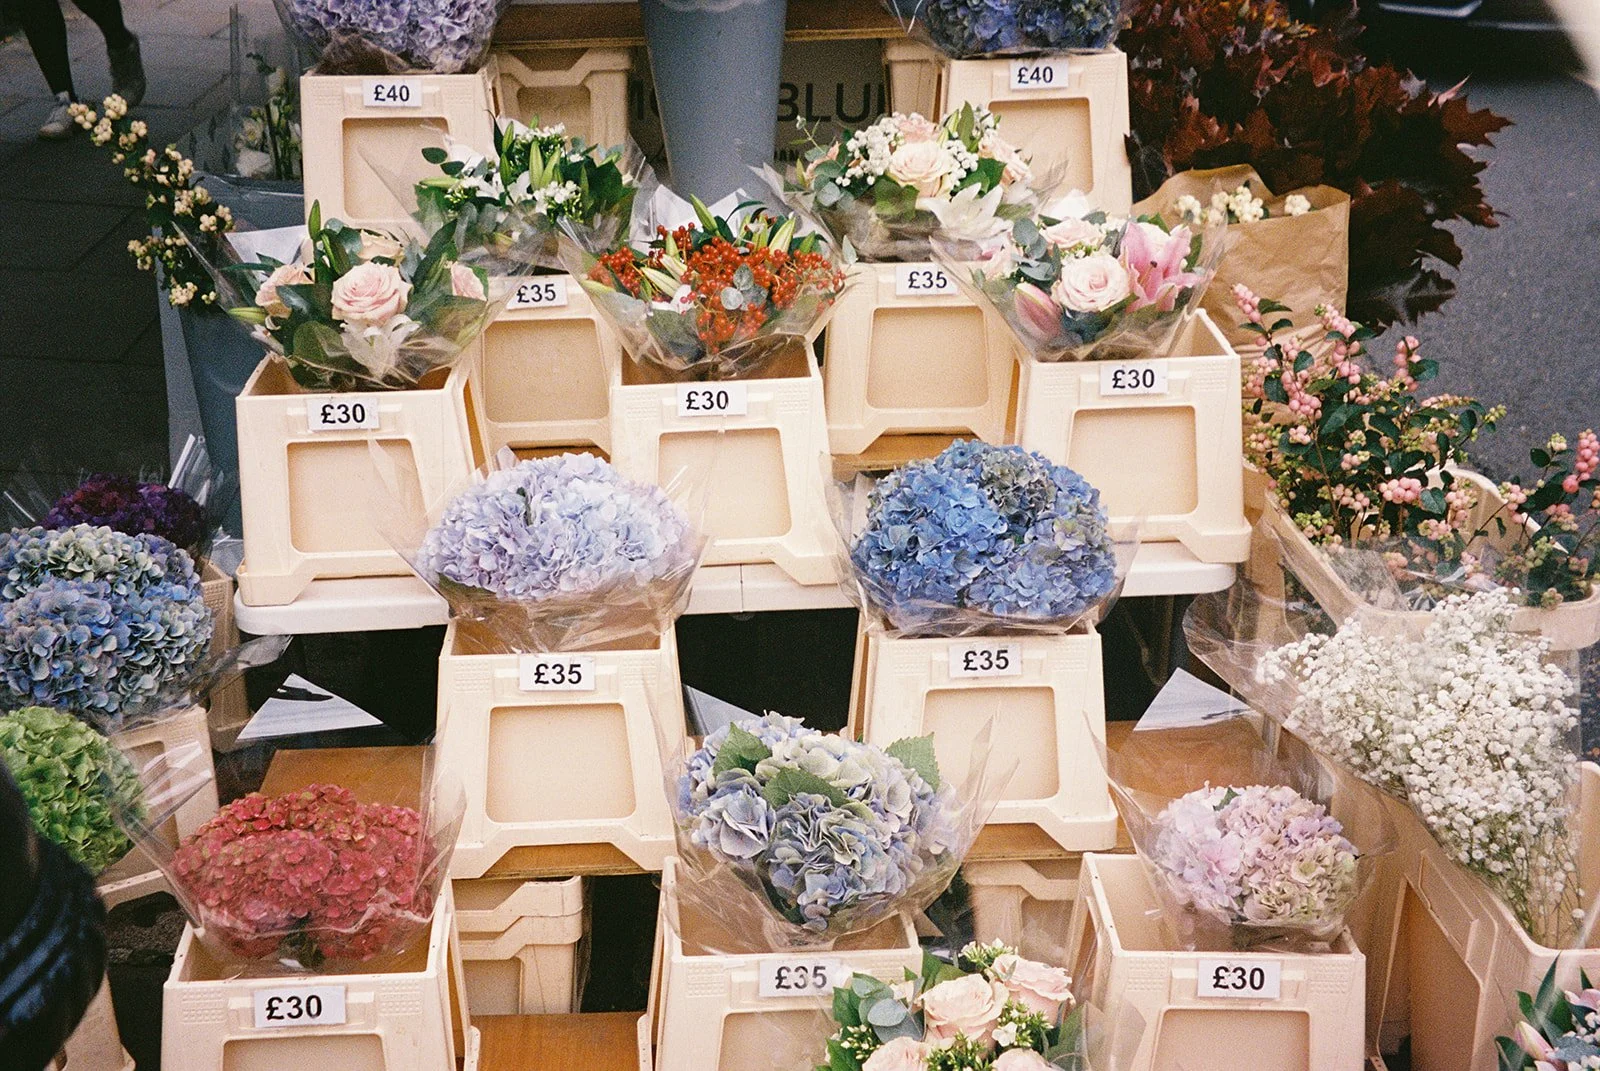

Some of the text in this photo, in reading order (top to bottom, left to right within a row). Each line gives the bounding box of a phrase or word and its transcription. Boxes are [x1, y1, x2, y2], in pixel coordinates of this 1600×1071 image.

[1017, 65, 1054, 84] £40
[373, 84, 410, 102] £40
[908, 270, 948, 289] £35
[516, 283, 556, 304] £35
[1112, 368, 1155, 389] £30
[685, 390, 729, 411] £30
[320, 403, 366, 424] £30
[963, 649, 1010, 671] £35
[534, 663, 582, 685] £35
[774, 965, 827, 990] £35
[1212, 965, 1265, 991] £30
[265, 994, 322, 1021] £30
